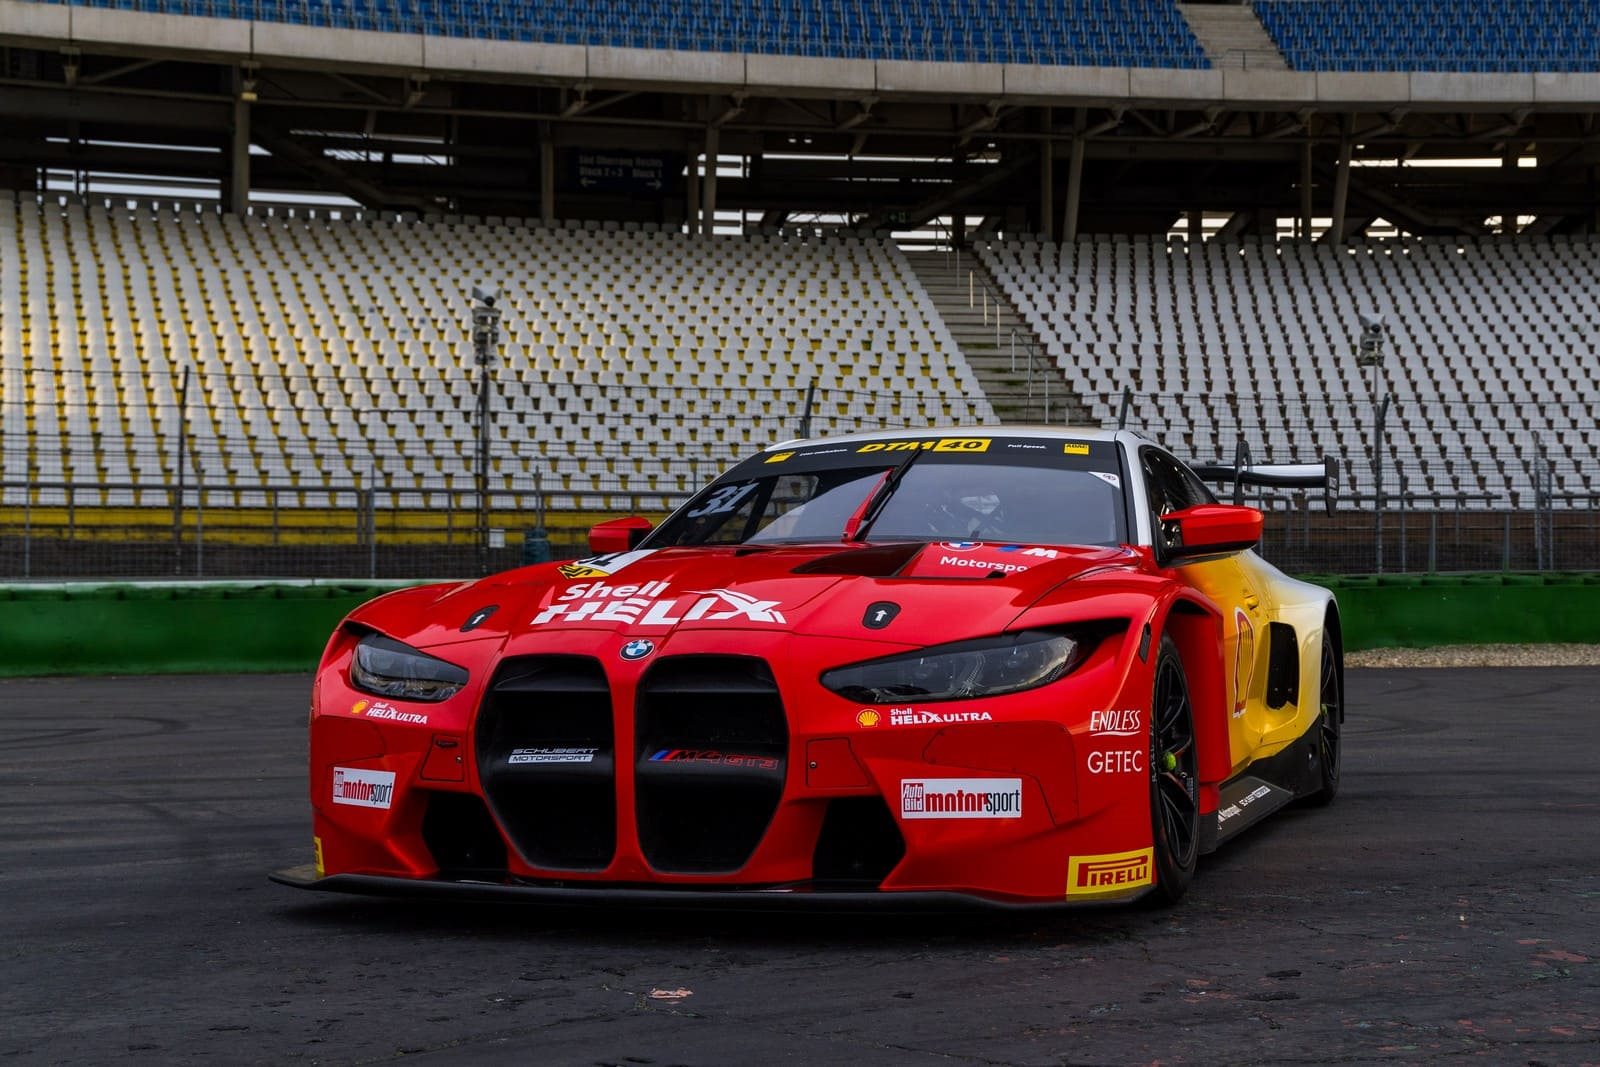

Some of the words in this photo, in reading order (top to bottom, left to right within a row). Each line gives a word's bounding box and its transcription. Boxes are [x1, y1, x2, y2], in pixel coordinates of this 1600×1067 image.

[856, 441, 935, 453] DTM
[942, 440, 984, 449] 40
[687, 482, 760, 518] 31
[1020, 547, 1059, 559] M
[557, 581, 671, 601] Shell
[530, 588, 787, 625] HELIX
[366, 706, 398, 719] HELIX
[397, 713, 428, 724] ULTRA
[890, 708, 913, 716] Shell
[891, 711, 943, 726] HELIX
[943, 712, 993, 723] ULTRA
[1089, 709, 1142, 732] ENDLESS
[511, 747, 598, 755] SCHUBERT
[512, 754, 592, 763] MOTORSPORT
[1087, 750, 1143, 774] GETEC
[343, 779, 393, 805] motorsport
[925, 789, 1021, 815] motorsport
[1076, 854, 1149, 888] PIRELLI
